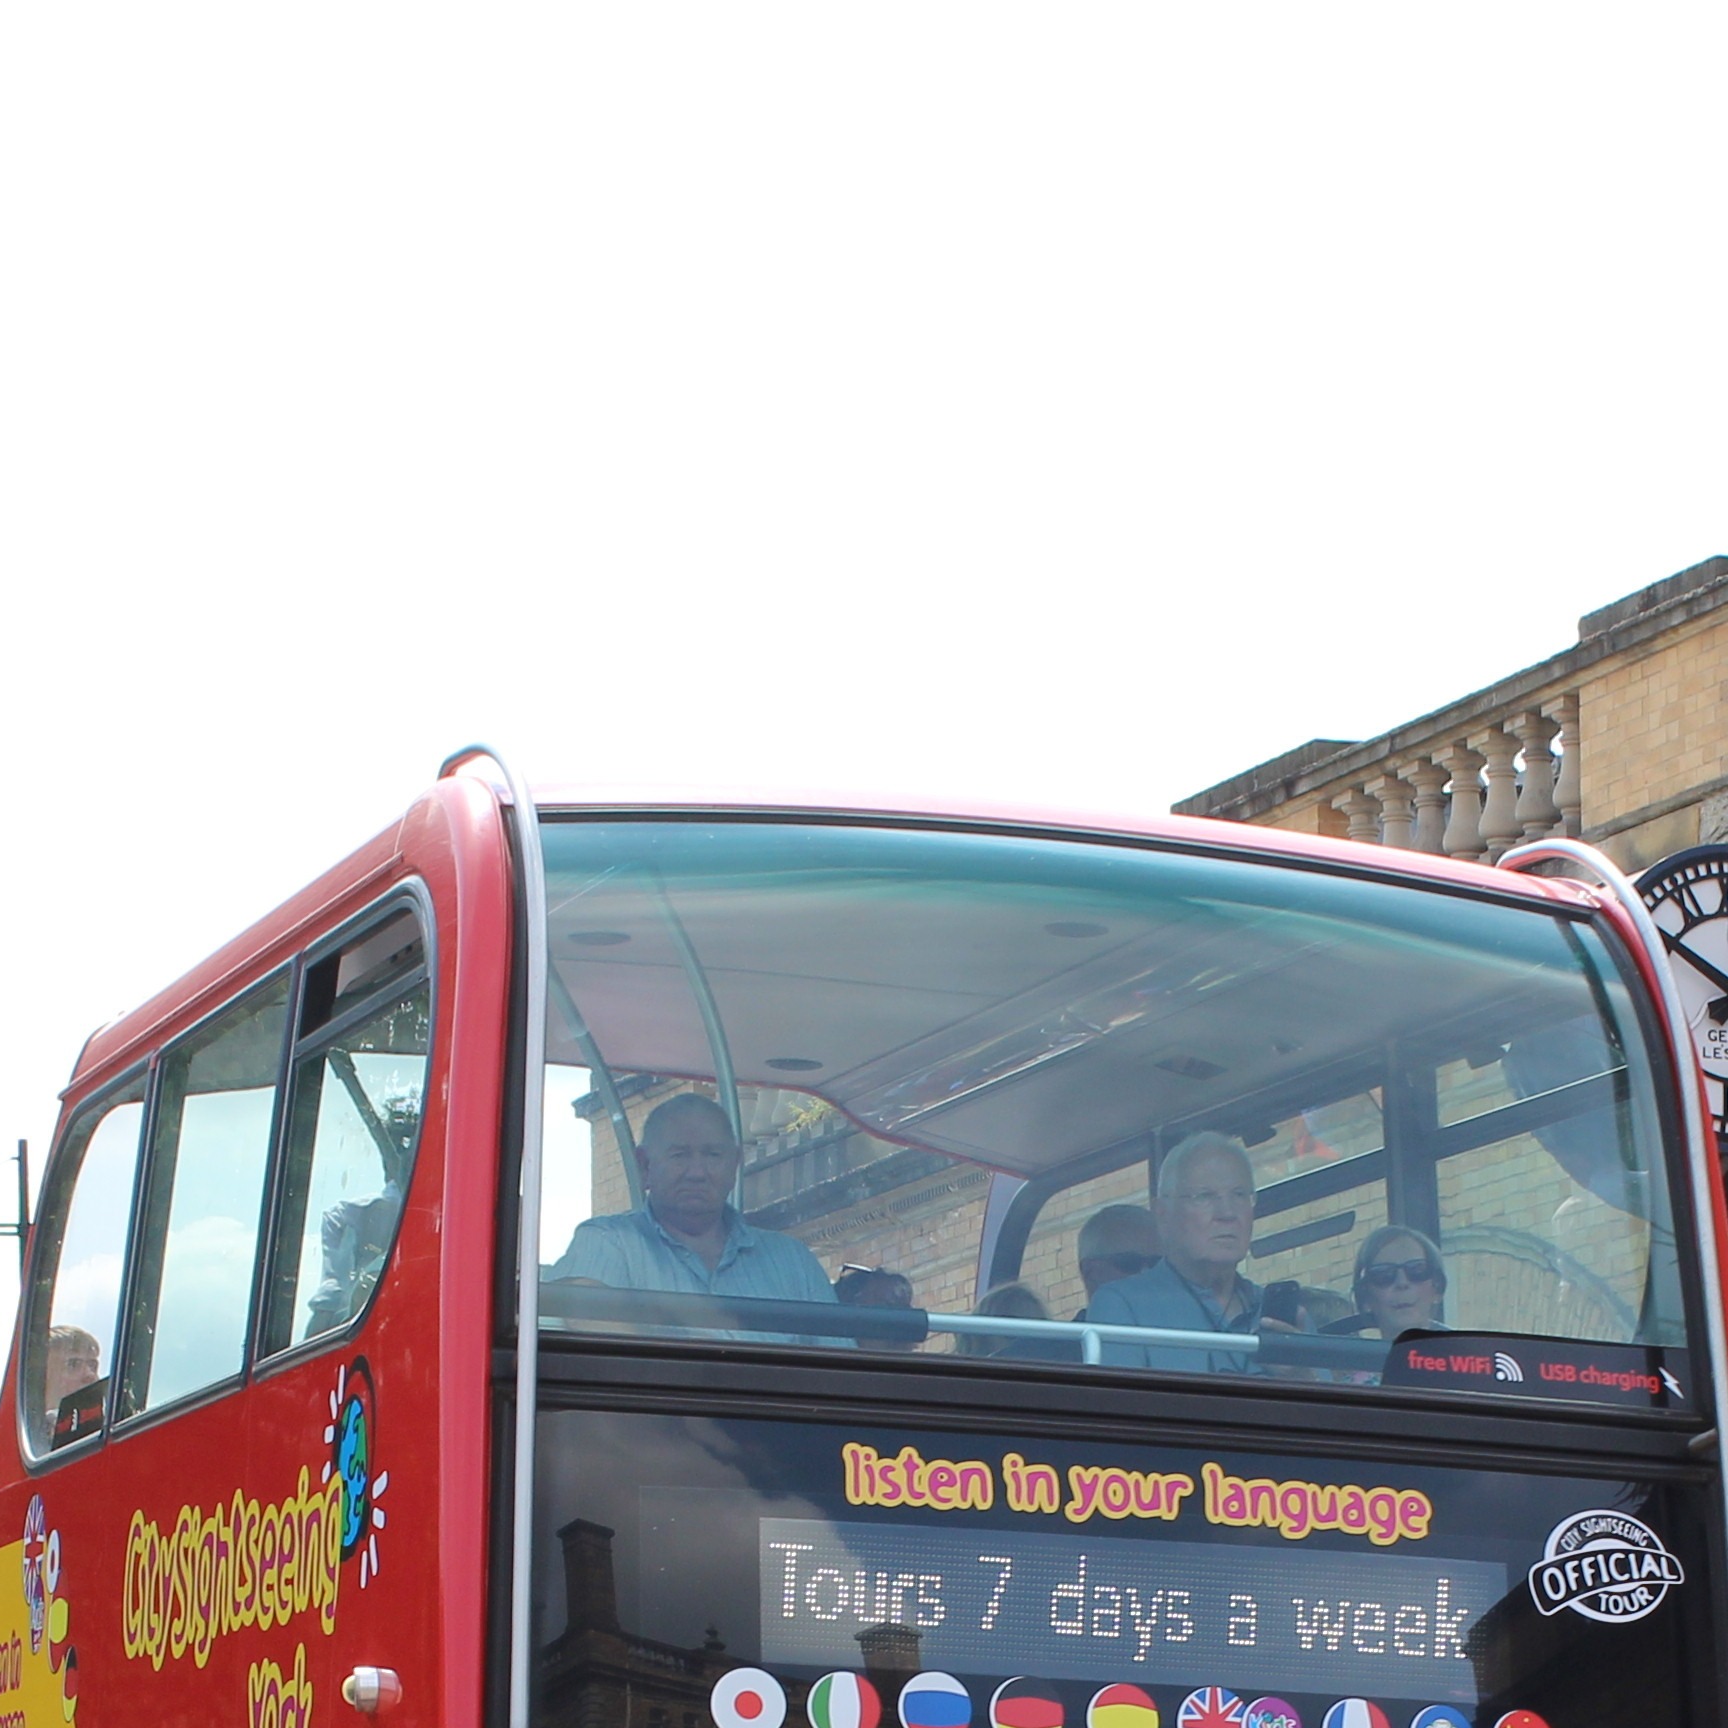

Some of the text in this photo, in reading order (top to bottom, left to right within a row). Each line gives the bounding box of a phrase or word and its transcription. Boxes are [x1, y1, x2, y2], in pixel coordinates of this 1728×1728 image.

[1407, 1350, 1491, 1375] free WiFi
[1539, 1363, 1661, 1394] USB charging
[842, 1442, 1433, 1546] listen in your language
[1560, 1517, 1649, 1551] CITY SIGHTSEEING
[1541, 1552, 1679, 1601] OFFICIAL
[768, 1540, 1470, 1663] Tours 7 days a week
[1598, 1586, 1655, 1615] TOUR
[9, 1629, 23, 1691] in
